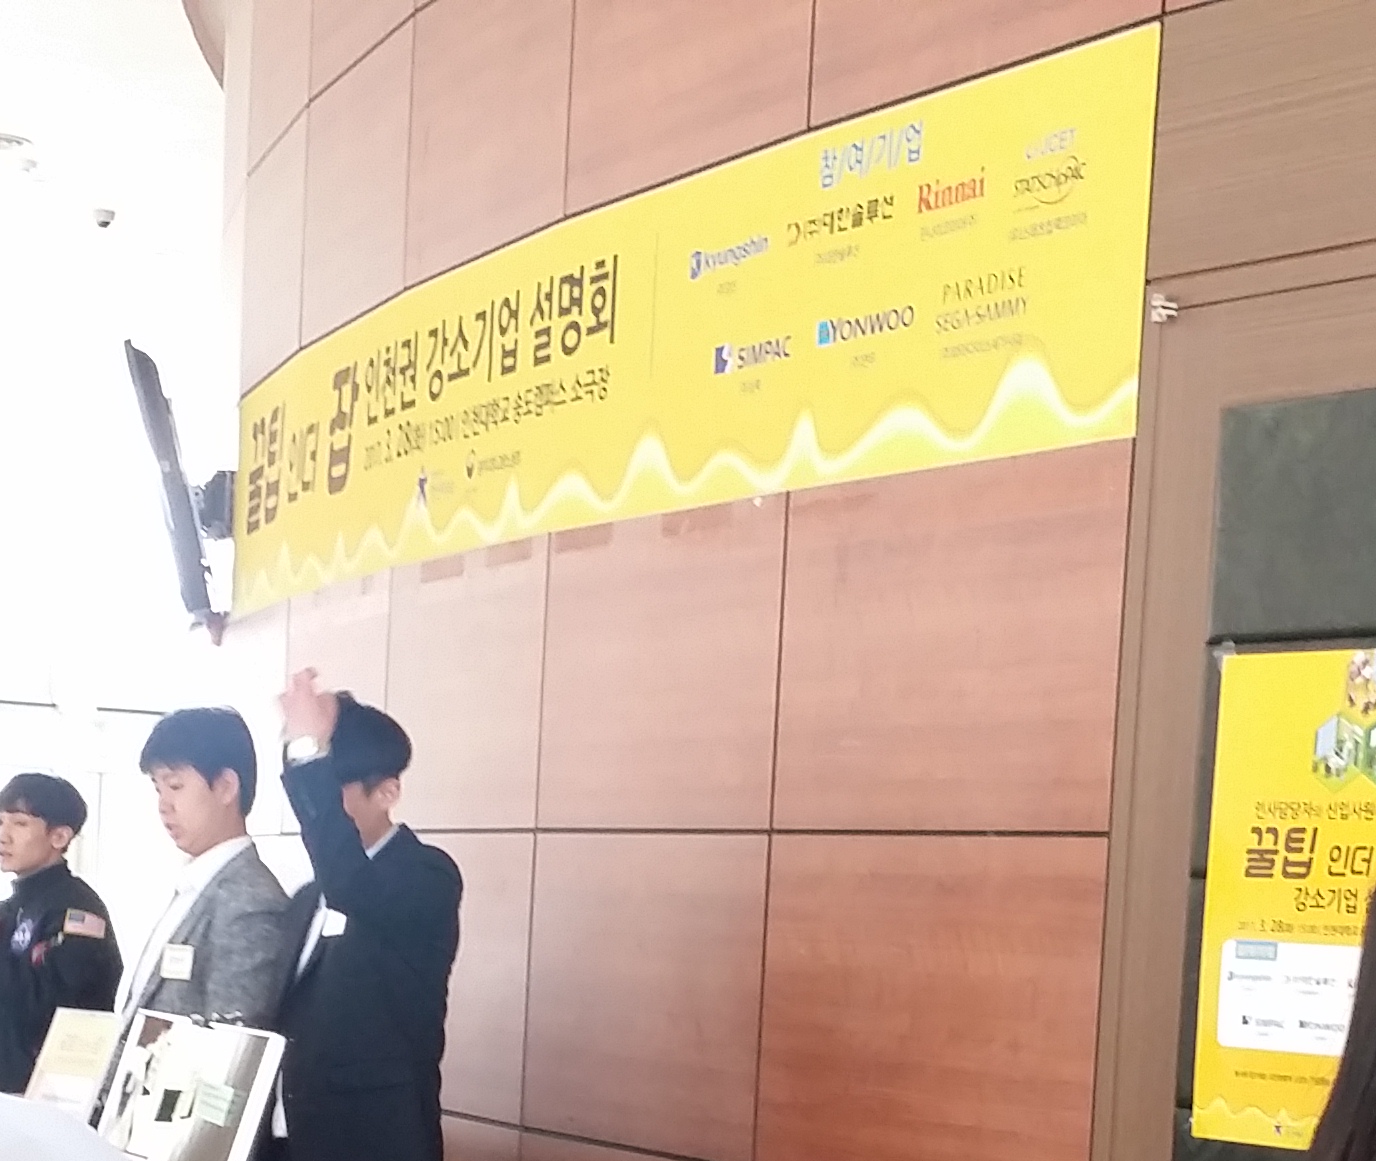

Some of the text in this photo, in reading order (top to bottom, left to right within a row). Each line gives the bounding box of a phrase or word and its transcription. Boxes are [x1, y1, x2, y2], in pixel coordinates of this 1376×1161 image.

[917, 166, 986, 214] Rinnai
[704, 235, 770, 271] kyungshin
[941, 267, 1027, 303] PARADISE
[829, 305, 916, 344] YONWOO
[736, 336, 794, 371] SIMPAC
[245, 401, 287, 536] 꿀팁
[327, 359, 360, 496] 잡
[364, 330, 419, 428] 인천권
[426, 289, 521, 400] 강소기업
[528, 254, 620, 367] 설명회
[1244, 826, 1319, 880] 꿀팁
[1327, 844, 1375, 878] 인더
[1293, 886, 1359, 915] 강소기업
